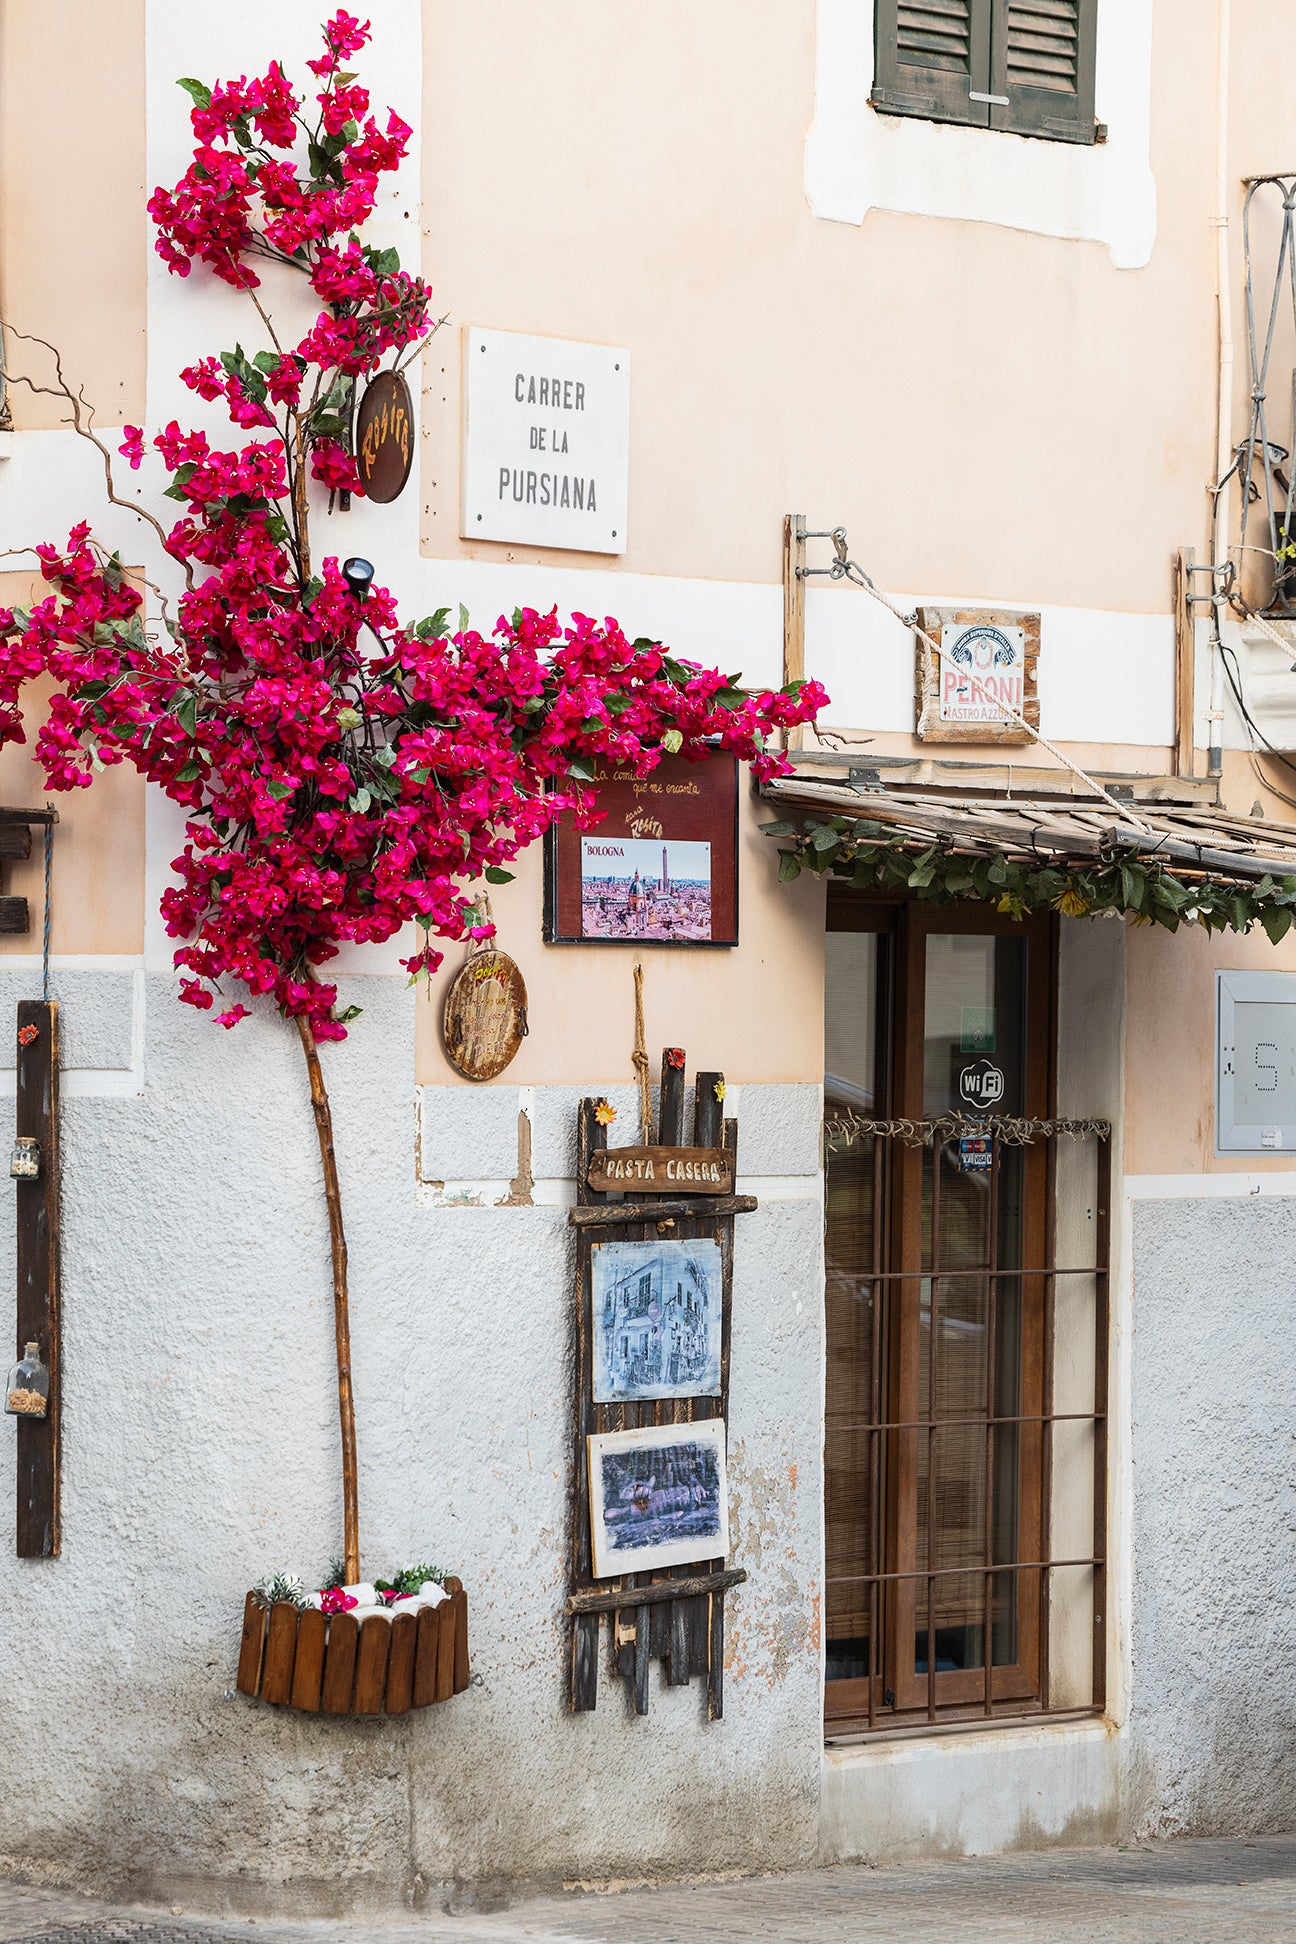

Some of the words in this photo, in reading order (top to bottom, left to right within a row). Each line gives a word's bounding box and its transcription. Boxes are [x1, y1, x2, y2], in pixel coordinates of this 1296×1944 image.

[515, 373, 585, 411] CARRER
[530, 426, 546, 451] DE
[553, 429, 568, 454] LA
[499, 467, 597, 512] PURSIANA
[944, 671, 1022, 705] PERONI
[944, 705, 979, 720] NASTRO
[980, 706, 1019, 721] AZZUR
[612, 769, 647, 782] comi
[649, 784, 664, 794] me
[665, 781, 701, 795] encanta
[587, 846, 625, 857] BOLOGNA
[606, 1159, 656, 1180] PASTA
[666, 1160, 721, 1182] CASERA
